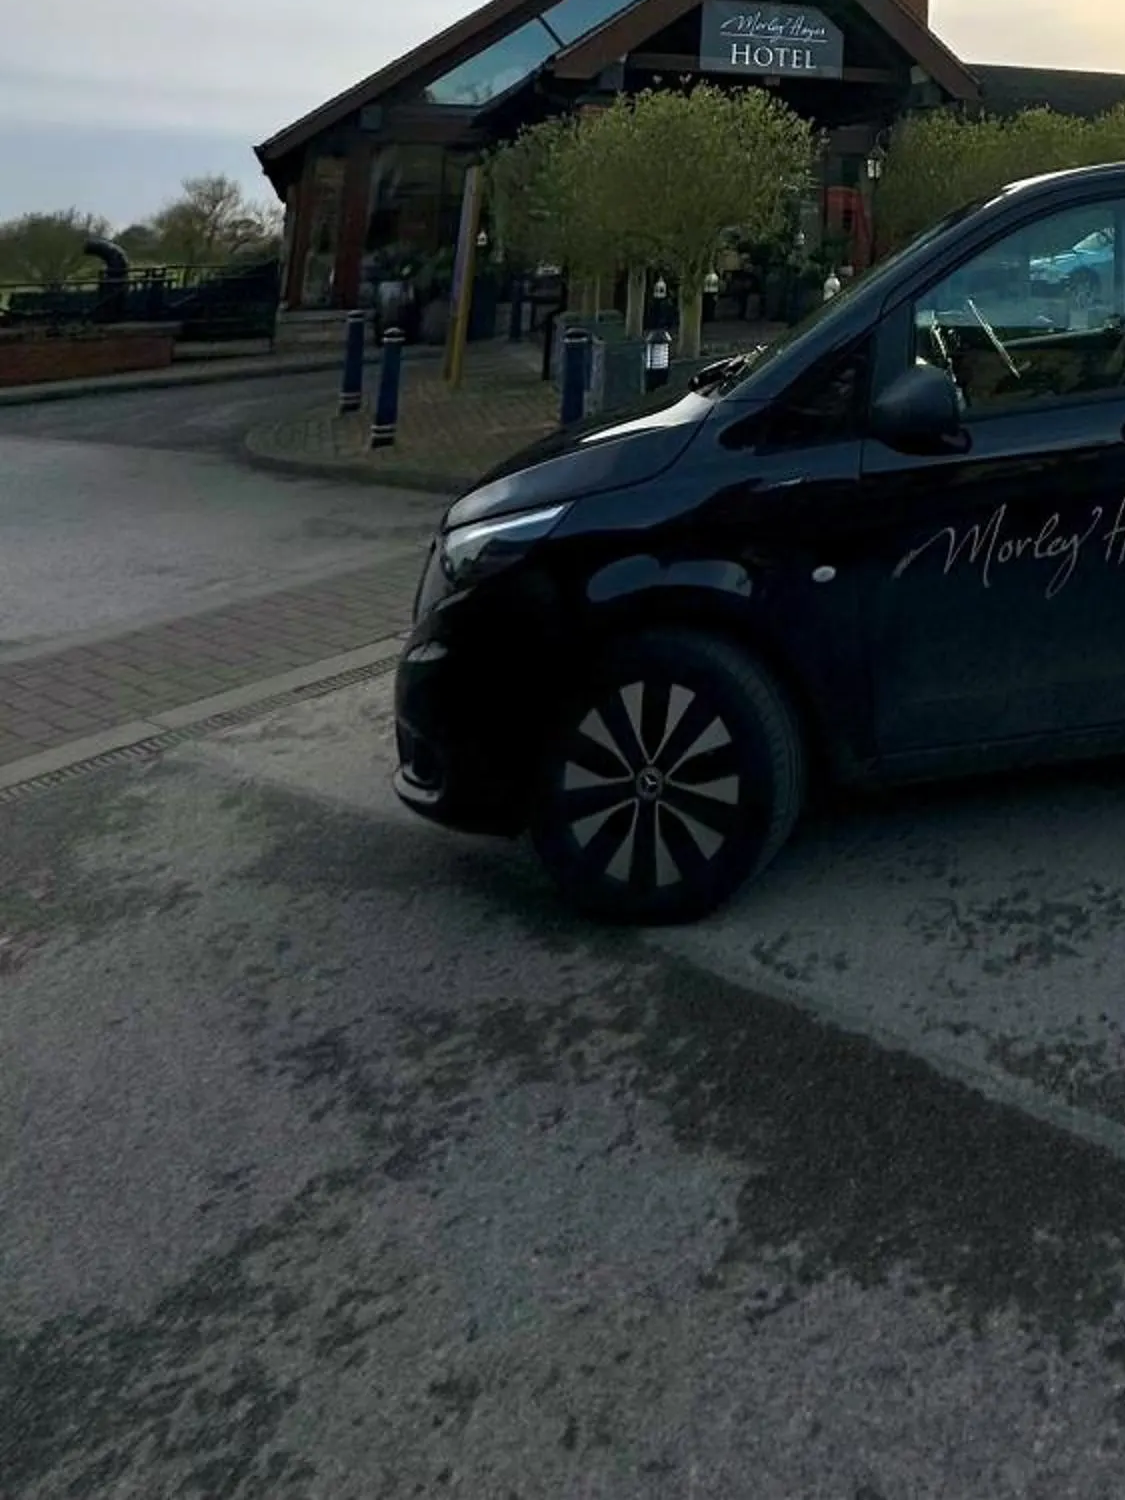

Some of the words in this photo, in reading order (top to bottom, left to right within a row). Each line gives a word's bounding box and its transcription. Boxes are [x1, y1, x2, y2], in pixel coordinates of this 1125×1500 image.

[720, 11, 790, 42] Morley
[788, 15, 826, 42] Hayes
[730, 43, 817, 69] HOTEL
[892, 503, 1103, 599] Morley
